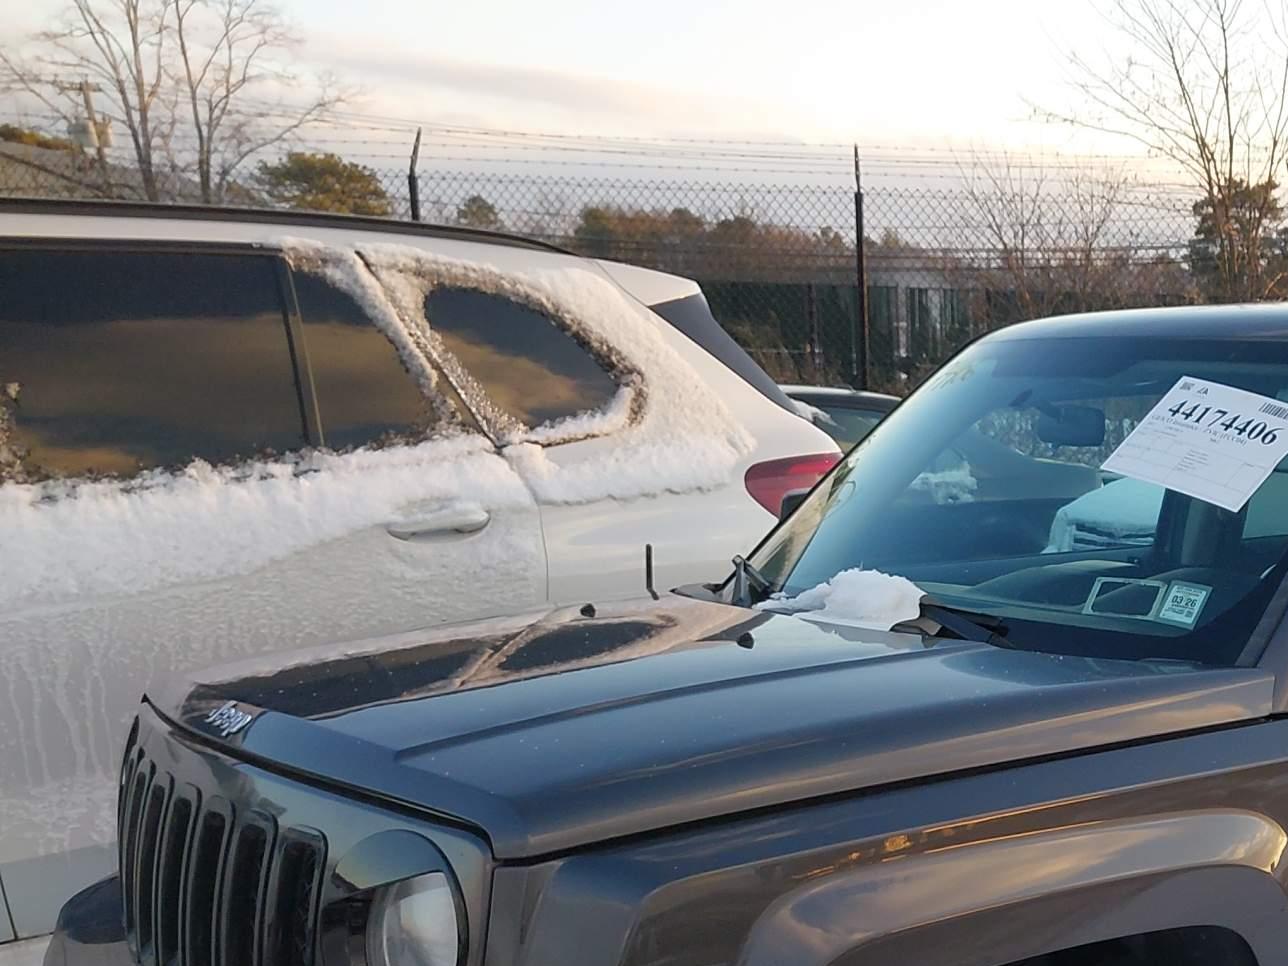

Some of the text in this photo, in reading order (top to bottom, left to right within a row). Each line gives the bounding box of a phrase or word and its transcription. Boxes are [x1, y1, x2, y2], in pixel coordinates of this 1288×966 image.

[1167, 399, 1285, 446] 44174406
[1172, 595, 1184, 604] 03
[1185, 597, 1197, 607] 26
[205, 700, 253, 736] Jeep
